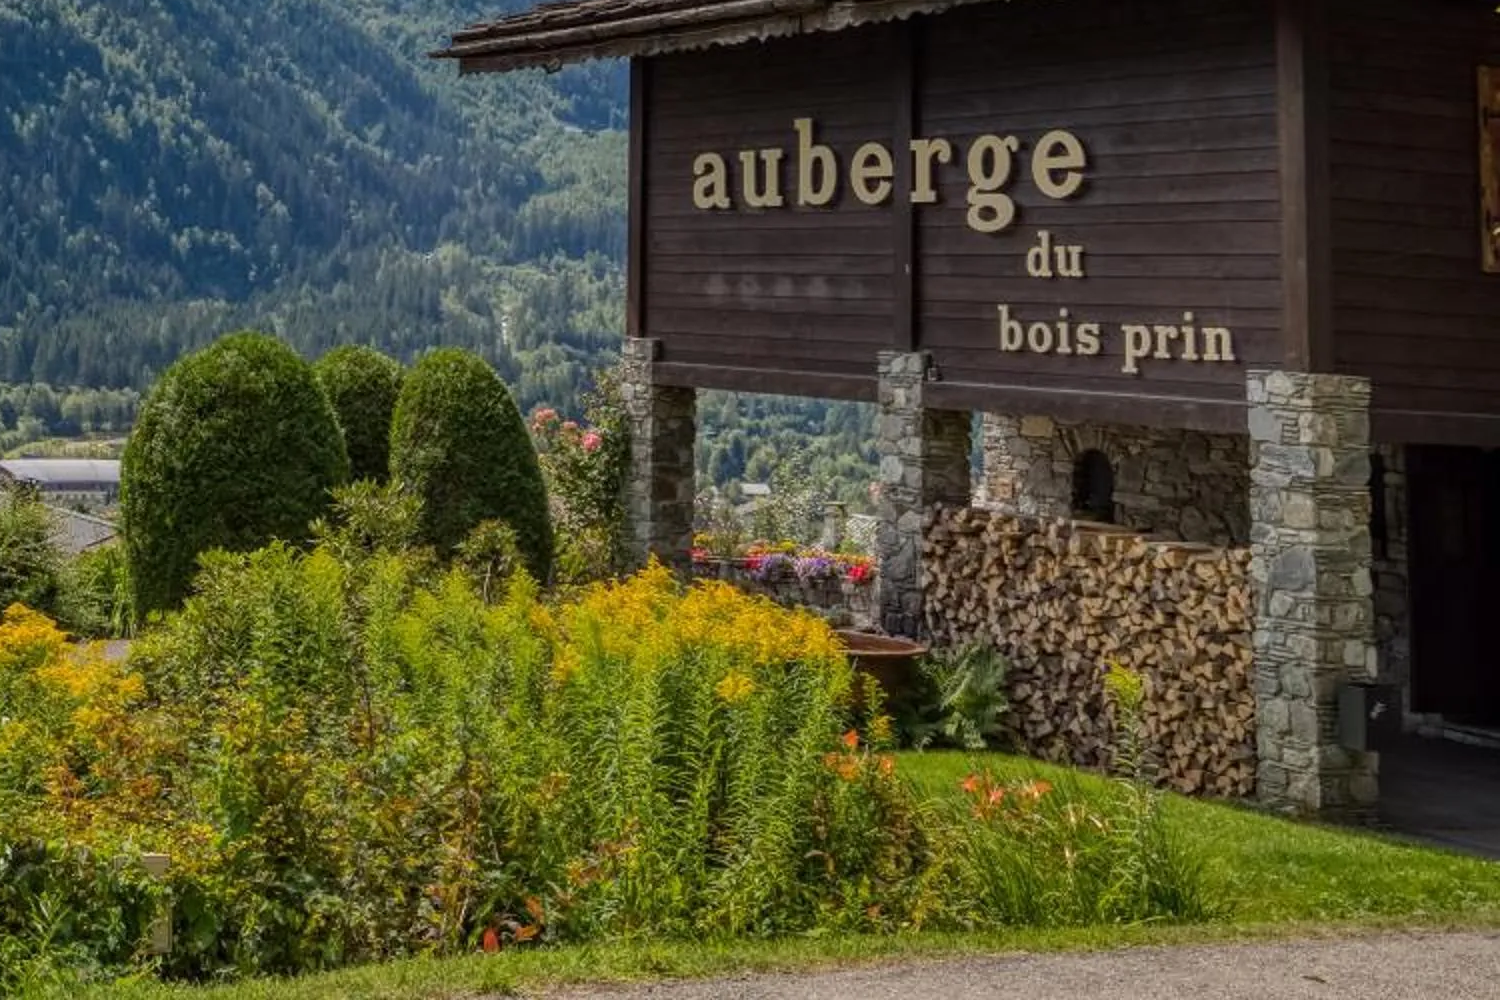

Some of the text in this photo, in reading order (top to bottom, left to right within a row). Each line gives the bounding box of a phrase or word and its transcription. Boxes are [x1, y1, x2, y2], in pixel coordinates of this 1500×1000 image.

[692, 118, 1086, 233] auberge
[1026, 230, 1084, 278] du
[998, 304, 1235, 374] bois prin
